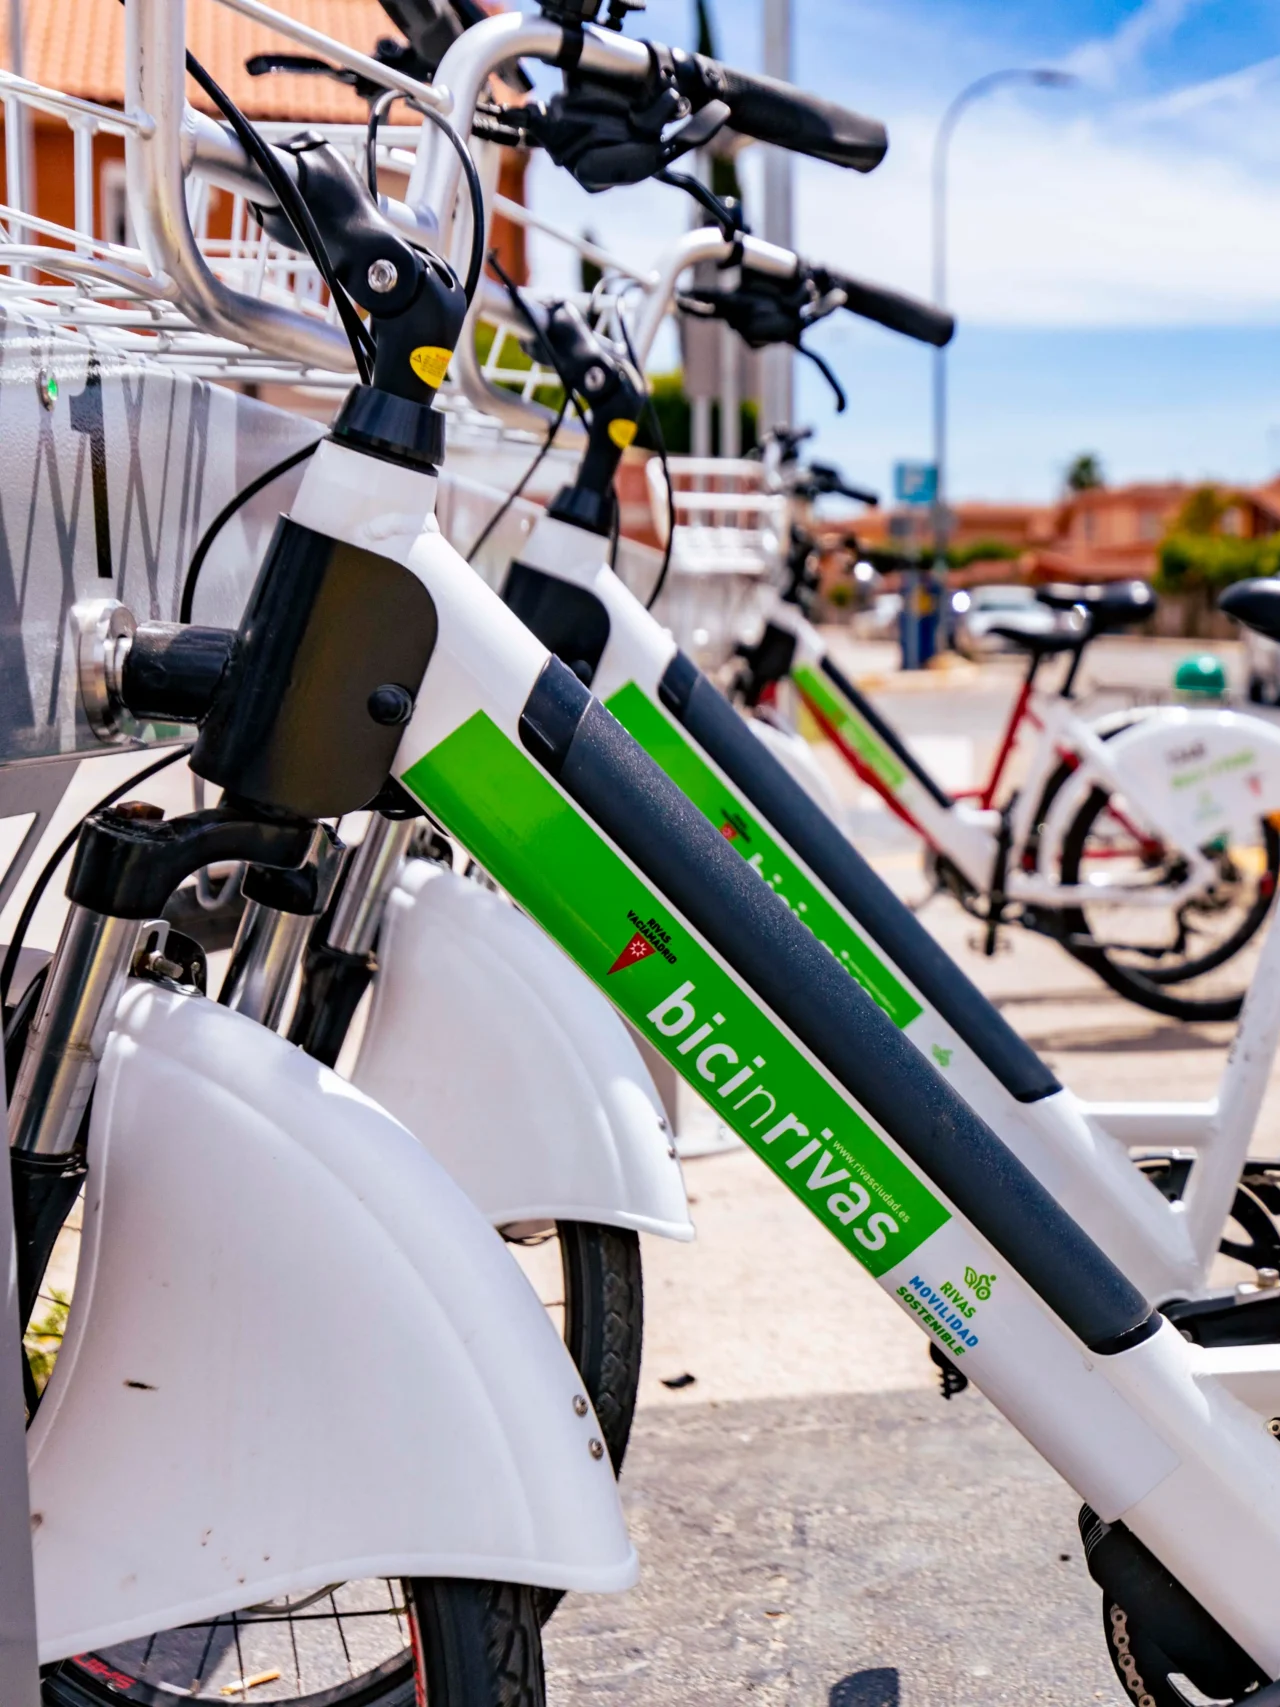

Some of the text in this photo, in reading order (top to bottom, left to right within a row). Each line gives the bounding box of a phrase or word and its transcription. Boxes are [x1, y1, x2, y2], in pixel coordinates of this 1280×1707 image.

[627, 910, 677, 965] VACIAMADRID
[647, 918, 672, 943] RIVAS
[646, 980, 900, 1251] bicinrivas
[833, 1140, 910, 1224] www.rivasciudad.es
[896, 1286, 965, 1356] SOSTENIBLE
[909, 1275, 979, 1348] MOVILIDAD
[940, 1281, 976, 1319] RIVAS
